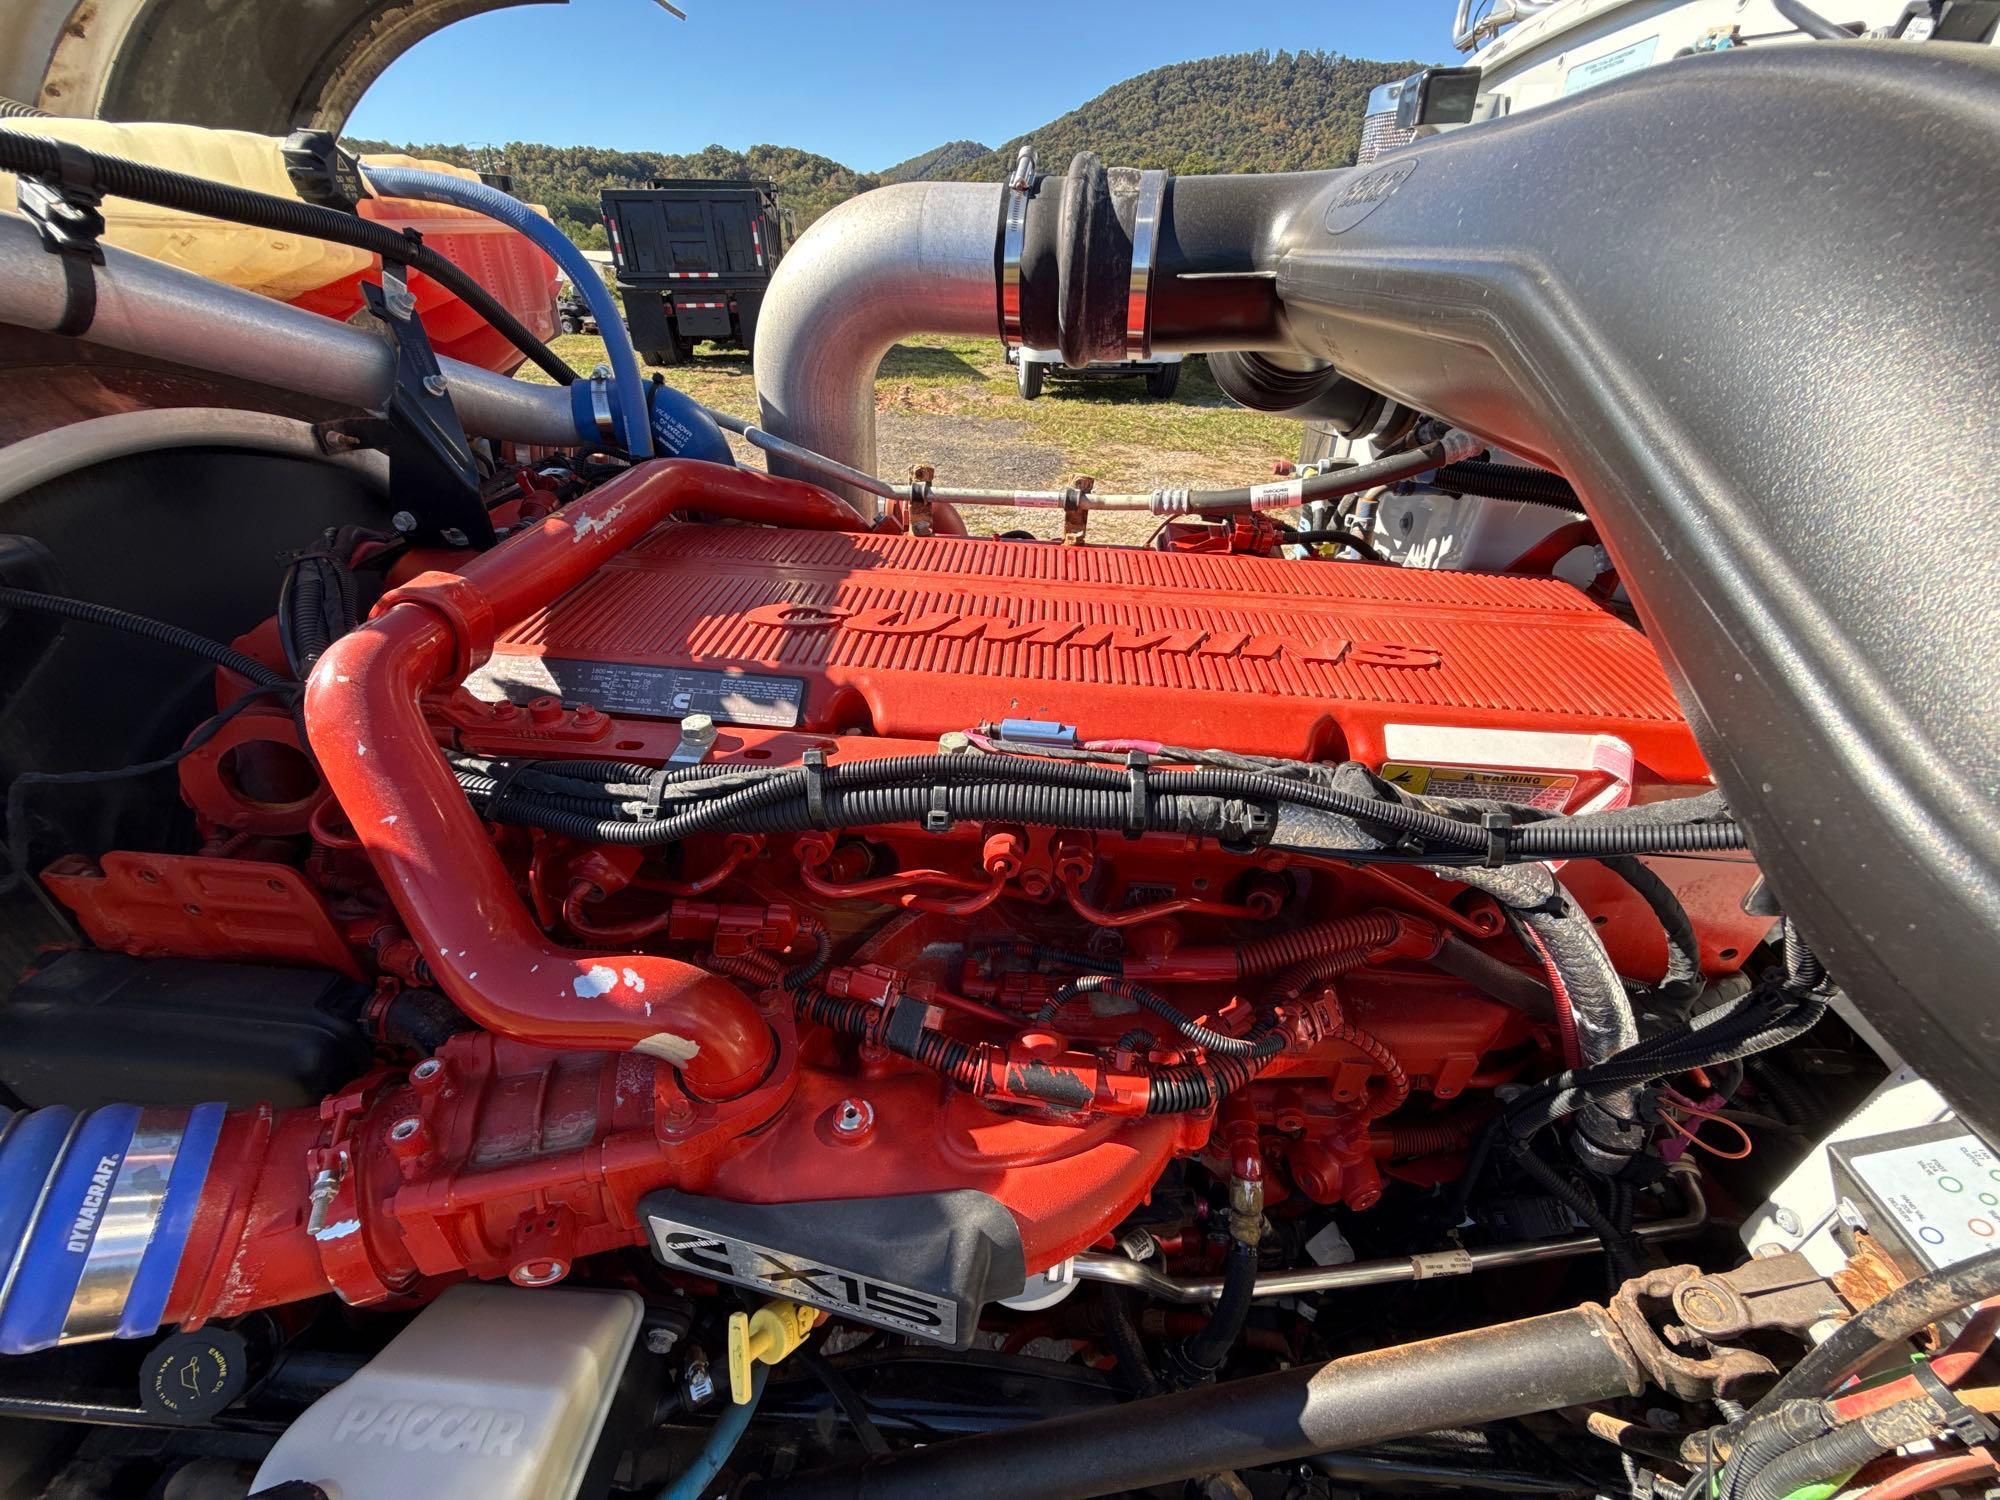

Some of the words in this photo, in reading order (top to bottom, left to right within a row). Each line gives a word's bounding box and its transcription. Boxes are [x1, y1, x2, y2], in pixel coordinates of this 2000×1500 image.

[746, 602, 1442, 670] CUMMINS
[1483, 775, 1541, 784] WARNING
[1932, 1159, 1949, 1172] FOOT
[1960, 1147, 1983, 1168] CLUTCH
[1887, 1197, 1912, 1222] DELIVERY
[667, 1238, 724, 1250] Cummins
[750, 1247, 943, 1327] X15
[159, 1355, 175, 1373] MAX
[208, 1347, 227, 1377] ENGINE
[155, 1375, 163, 1391] FILL
[211, 1380, 224, 1393] OIL
[164, 1399, 178, 1410] GAL
[330, 1400, 528, 1456] PACCAR
